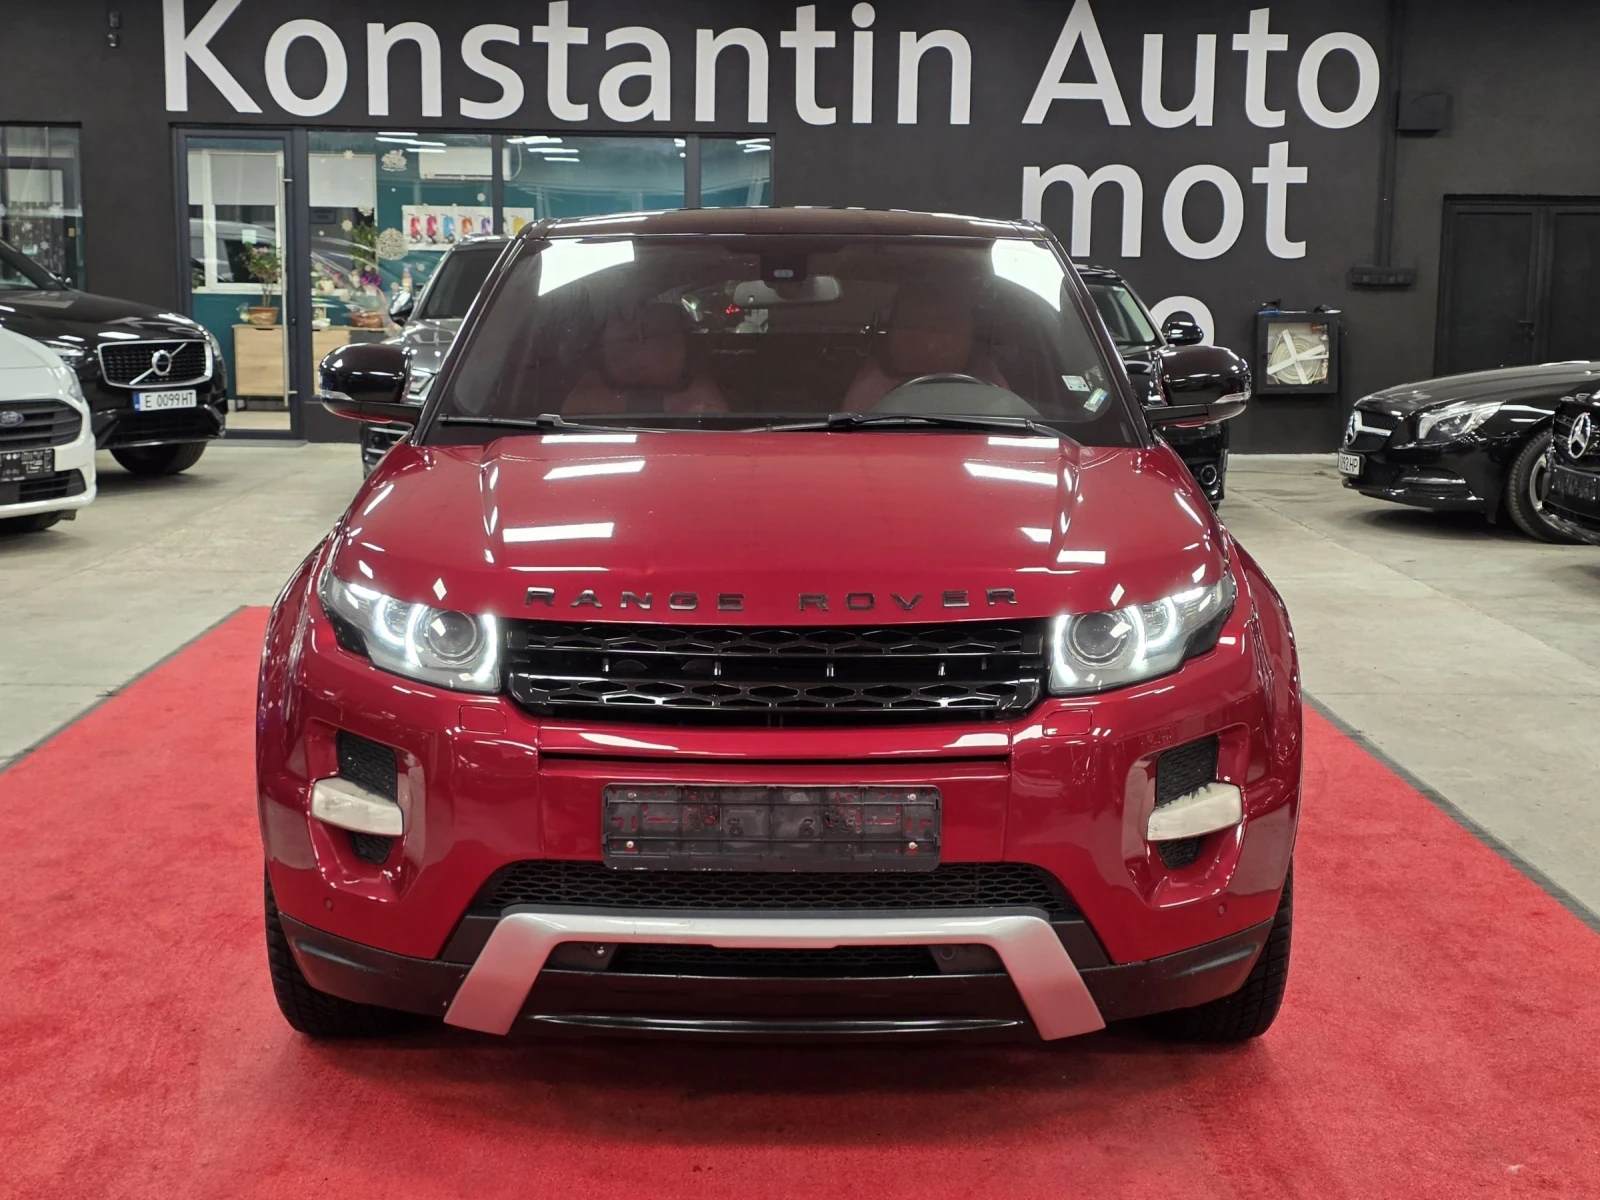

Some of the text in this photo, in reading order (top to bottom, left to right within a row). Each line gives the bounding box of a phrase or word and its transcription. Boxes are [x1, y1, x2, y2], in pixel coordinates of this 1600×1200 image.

[163, 0, 1381, 129] Konstantin Auto
[1021, 140, 1308, 260] mot
[145, 395, 152, 408] E
[525, 586, 1018, 611] RANGE ROVER
